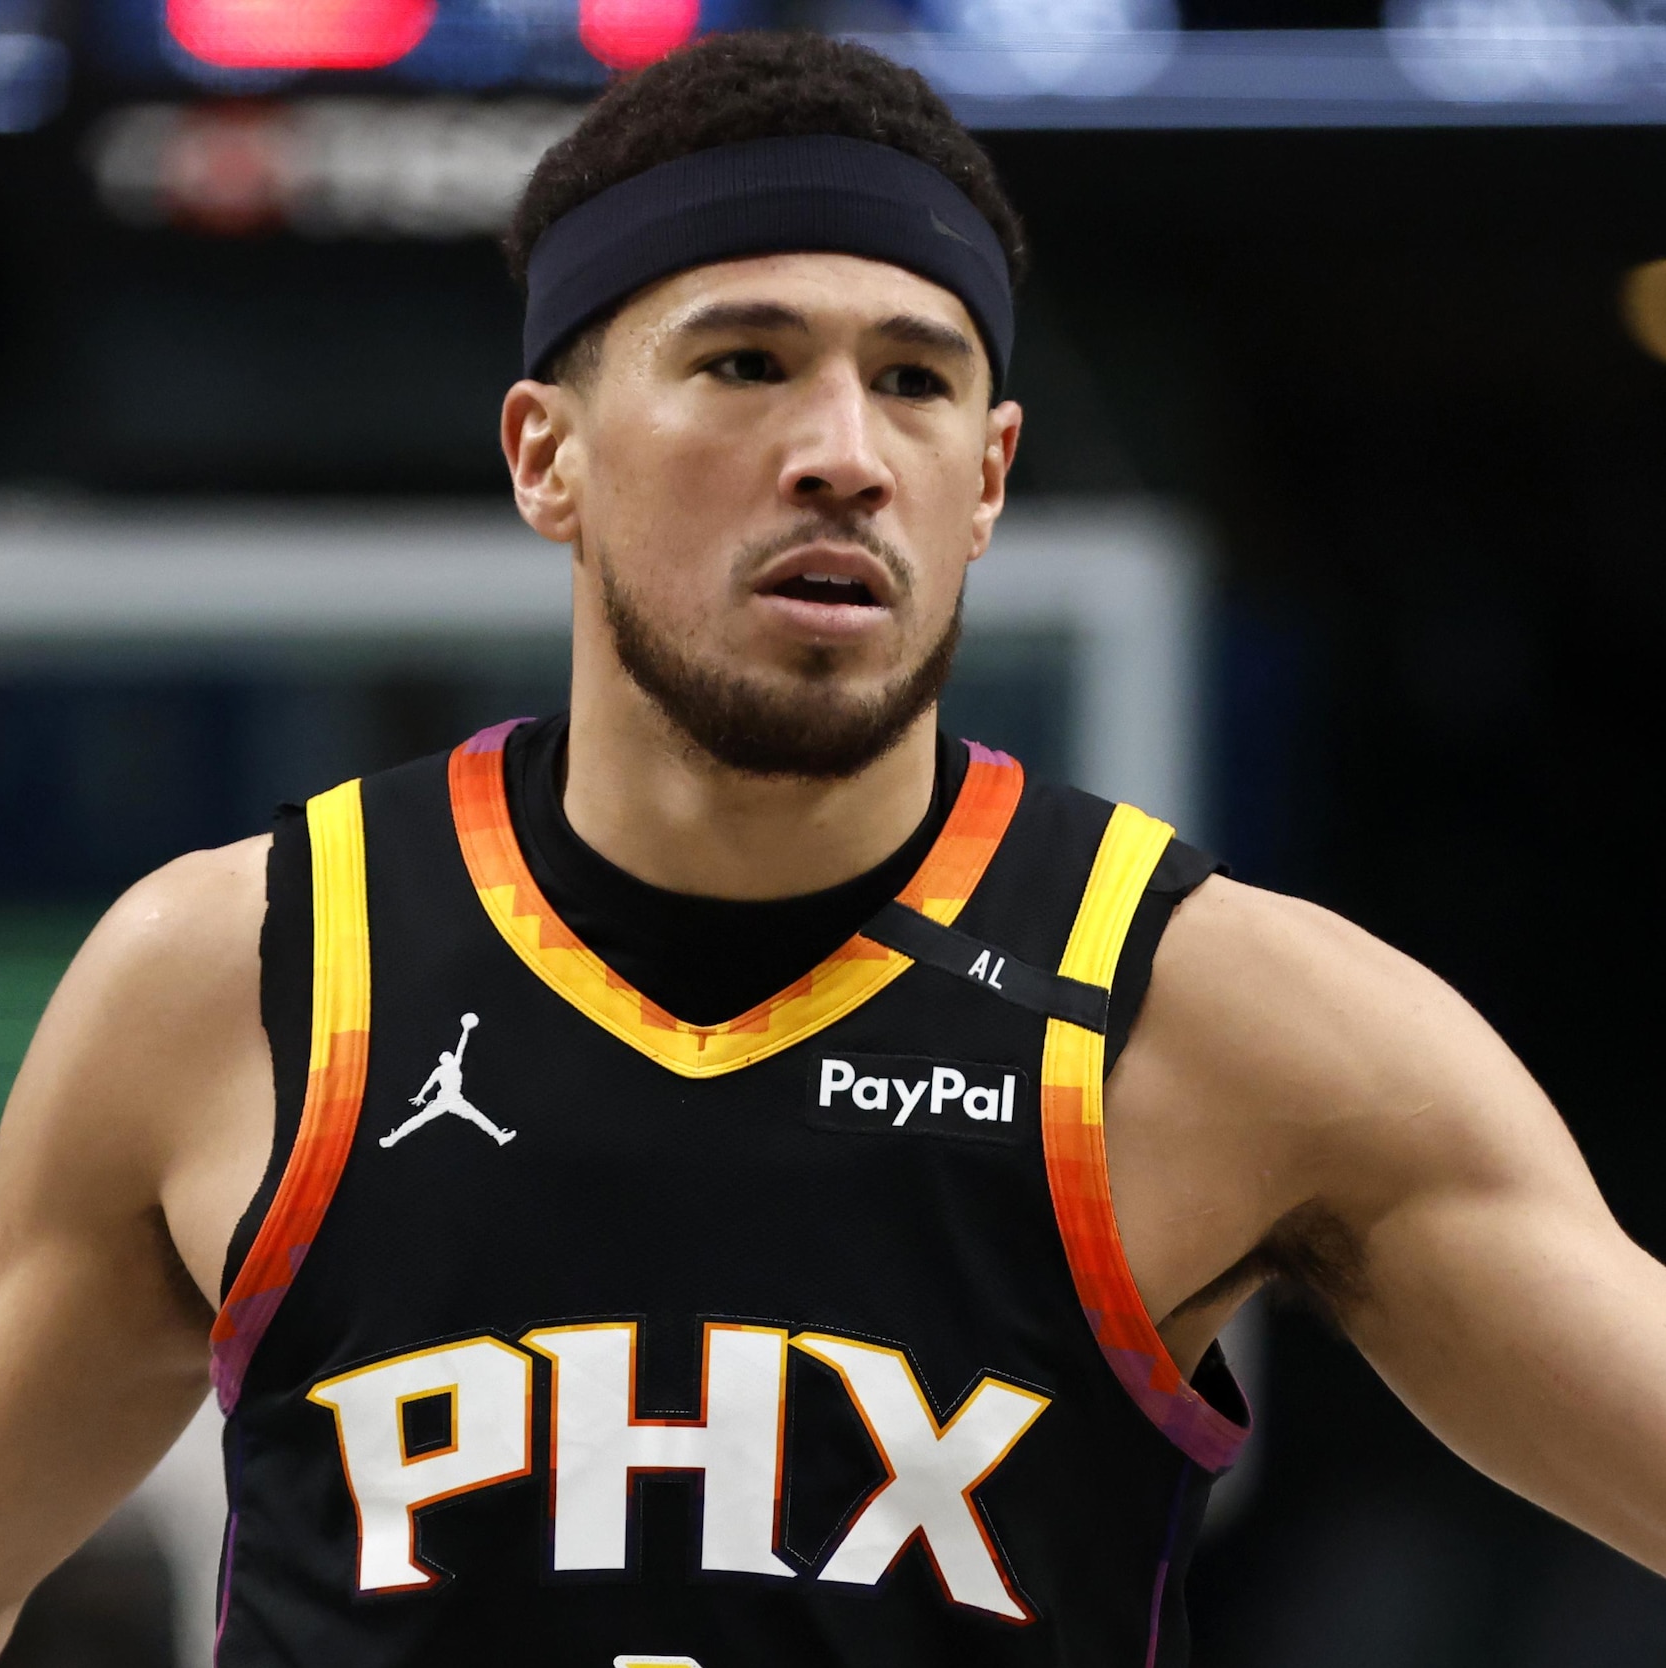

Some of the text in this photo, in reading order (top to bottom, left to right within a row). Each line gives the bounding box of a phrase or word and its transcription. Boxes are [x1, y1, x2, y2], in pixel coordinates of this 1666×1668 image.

[967, 949, 1006, 990] AL
[819, 1058, 1016, 1126] PayPal
[305, 1321, 1053, 1626] PHX
